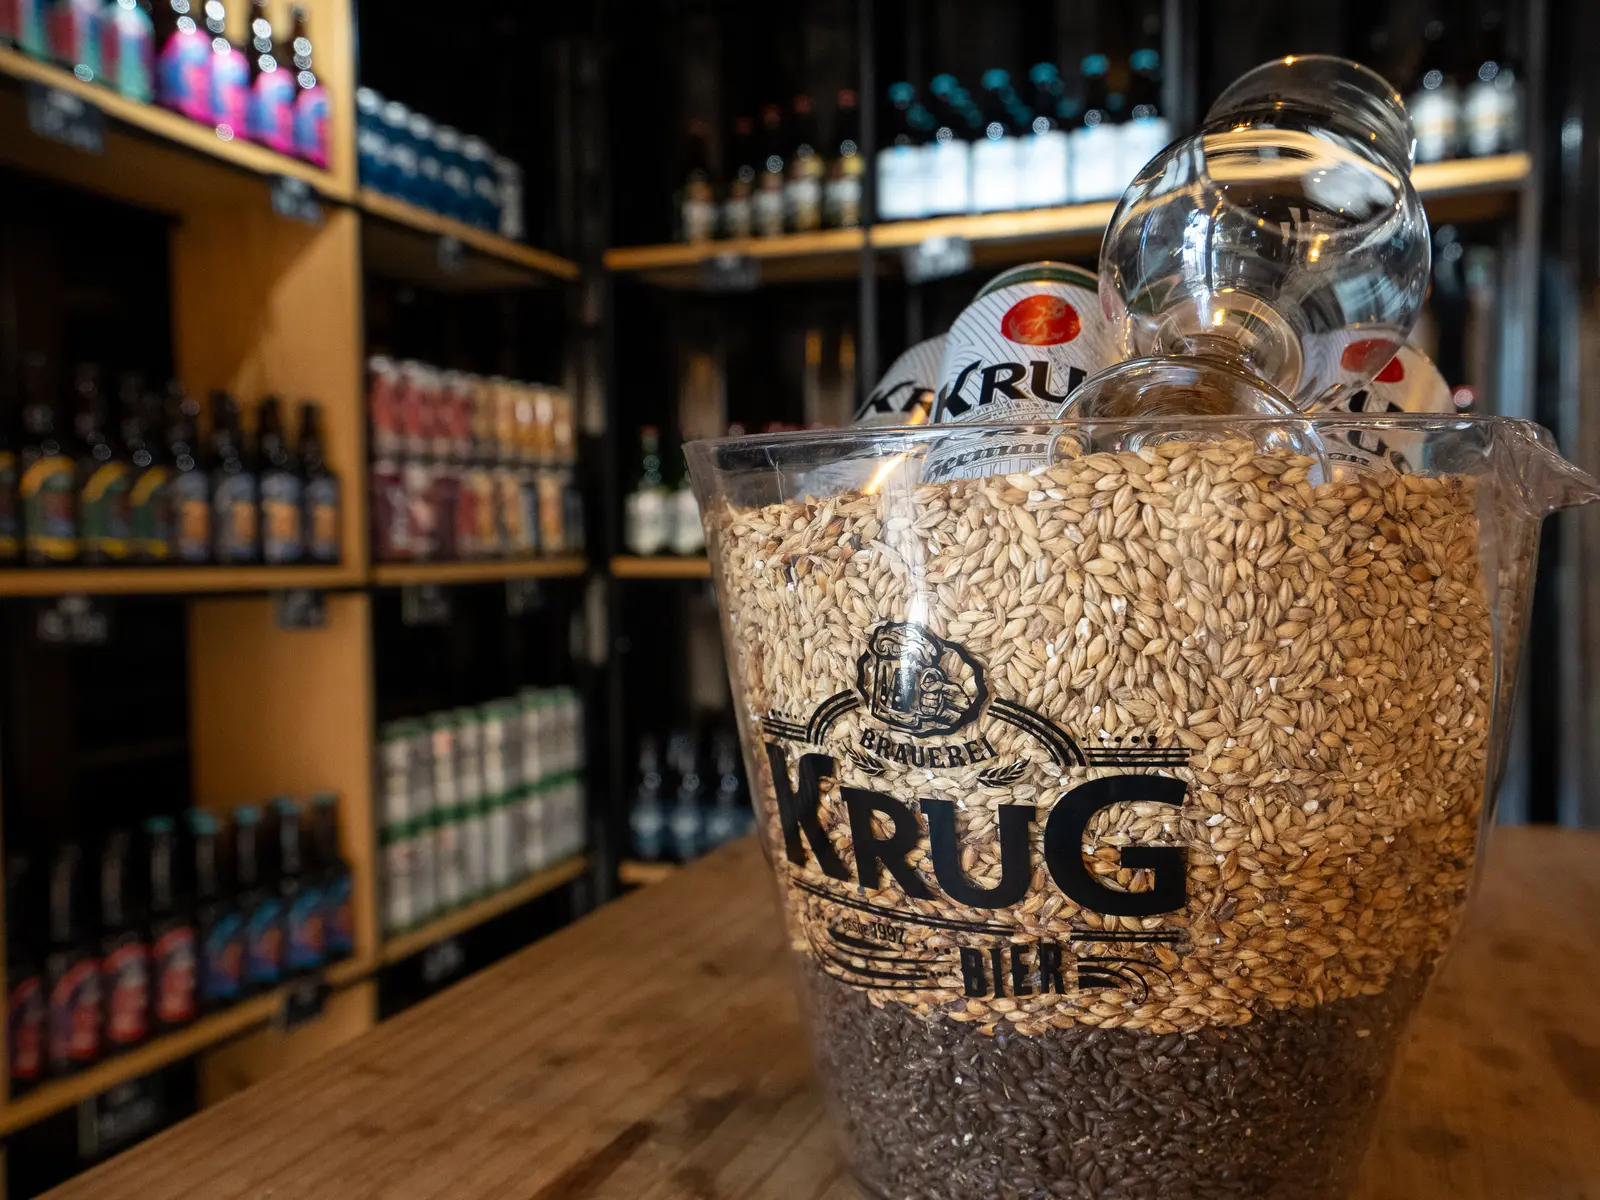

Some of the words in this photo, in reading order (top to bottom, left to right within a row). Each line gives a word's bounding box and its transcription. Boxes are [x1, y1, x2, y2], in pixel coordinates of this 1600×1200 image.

[859, 727, 998, 768] BRAUEREI
[764, 742, 1188, 916] KRUG
[870, 921, 905, 945] 1997
[959, 942, 1065, 997] BIER
